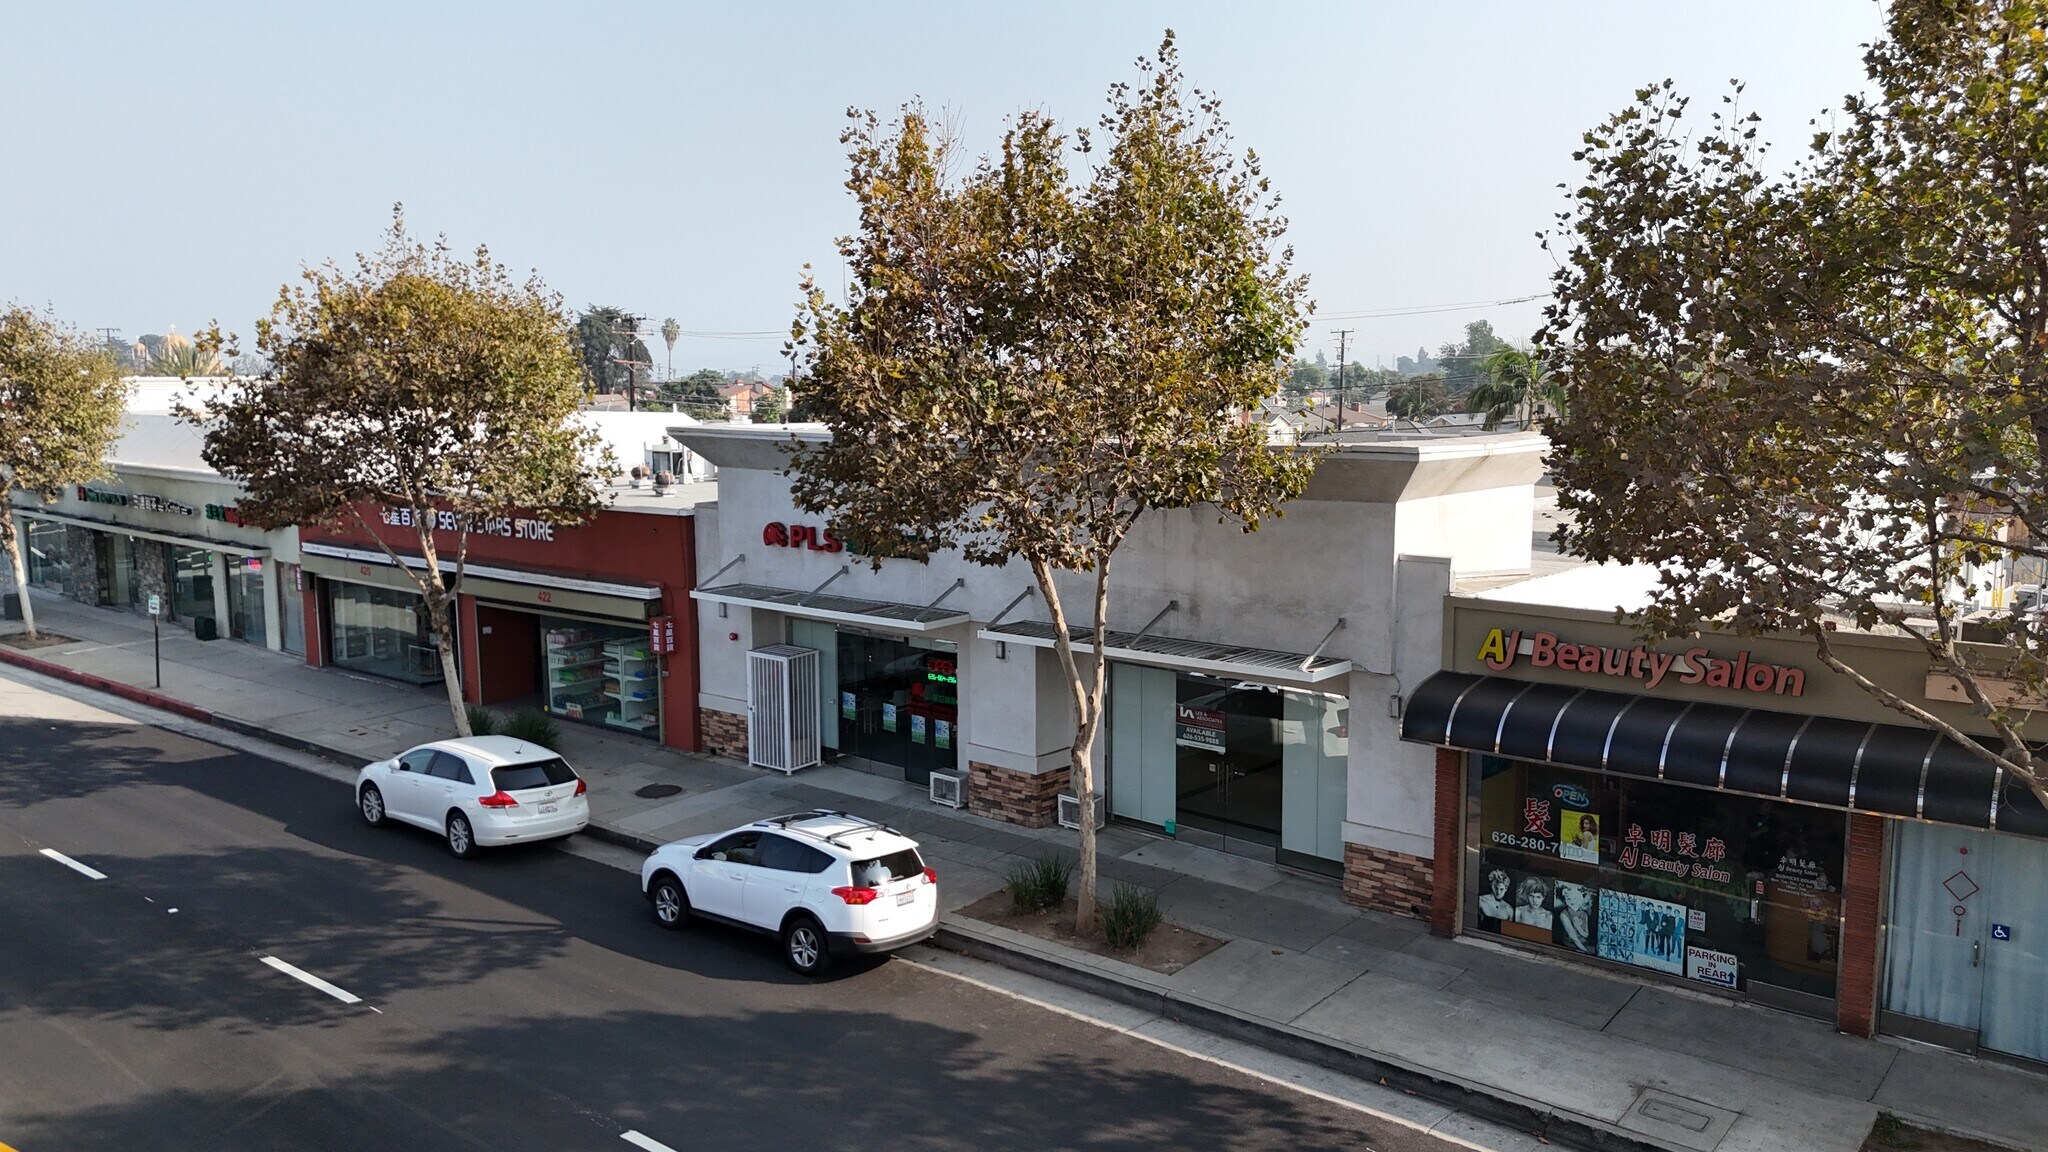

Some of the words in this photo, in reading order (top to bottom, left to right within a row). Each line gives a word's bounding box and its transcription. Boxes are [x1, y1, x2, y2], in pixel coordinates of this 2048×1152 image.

[515, 518, 554, 541] STORE
[790, 525, 843, 553] PLS
[360, 565, 371, 576] 420
[537, 591, 551, 603] 422
[1477, 627, 1522, 671] AJ
[1530, 631, 1673, 689] Beauty
[1680, 646, 1806, 697] Salon
[1185, 727, 1216, 738] AVAILABLE
[1554, 788, 1586, 801] OPEN
[1523, 797, 1554, 838] 髮
[1625, 823, 1726, 862] 卓明髮廊
[1618, 846, 1639, 869] AJ
[1641, 853, 1689, 877] Beauty
[1691, 863, 1730, 883] Salon
[1688, 948, 1736, 966] PARKING
[1697, 966, 1727, 980] REAR
